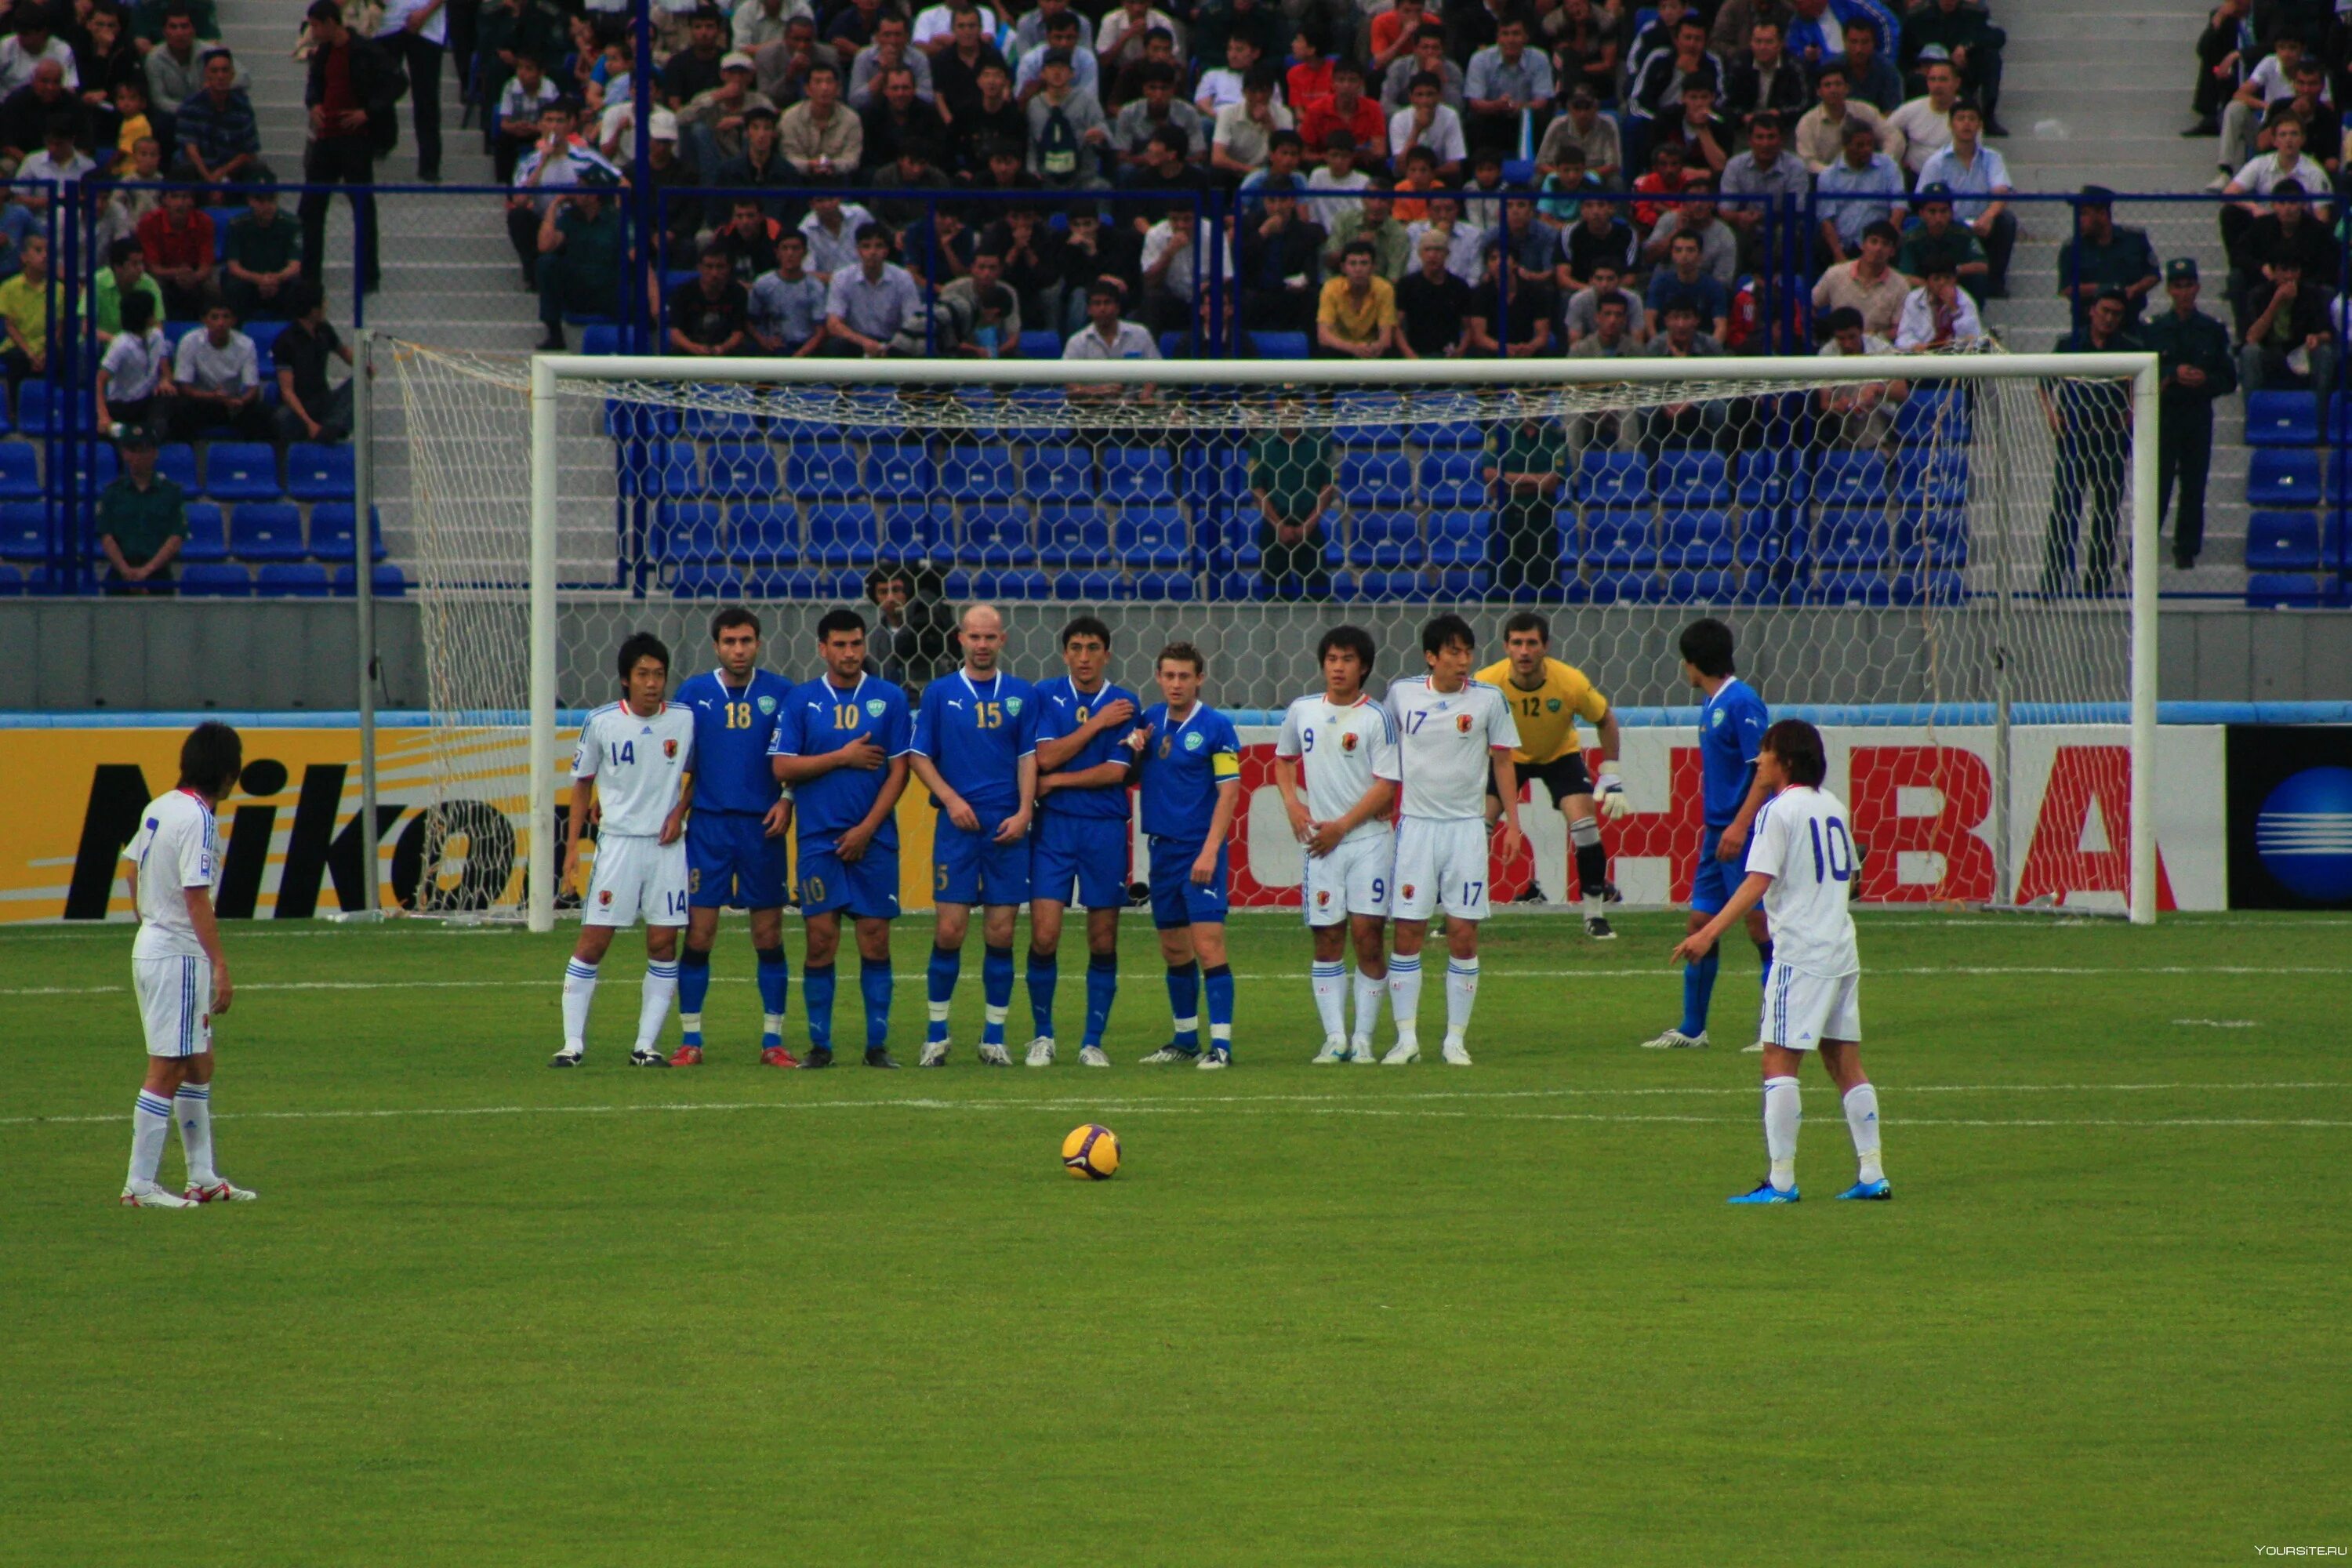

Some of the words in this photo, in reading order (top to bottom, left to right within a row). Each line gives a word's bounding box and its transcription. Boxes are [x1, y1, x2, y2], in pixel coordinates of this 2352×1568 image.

[724, 702, 751, 729] 18
[833, 704, 859, 730] 10
[975, 702, 1002, 728] 15
[1522, 697, 1540, 717] 12
[1406, 710, 1428, 735] 17
[612, 740, 634, 766] 14
[1159, 734, 1172, 759] 8
[1304, 728, 1315, 753] 9
[140, 817, 159, 878] 7
[1809, 816, 1851, 884] 10
[667, 889, 687, 916] 14
[802, 876, 826, 906] 10
[1371, 877, 1385, 903] 9
[1463, 881, 1483, 906] 17
